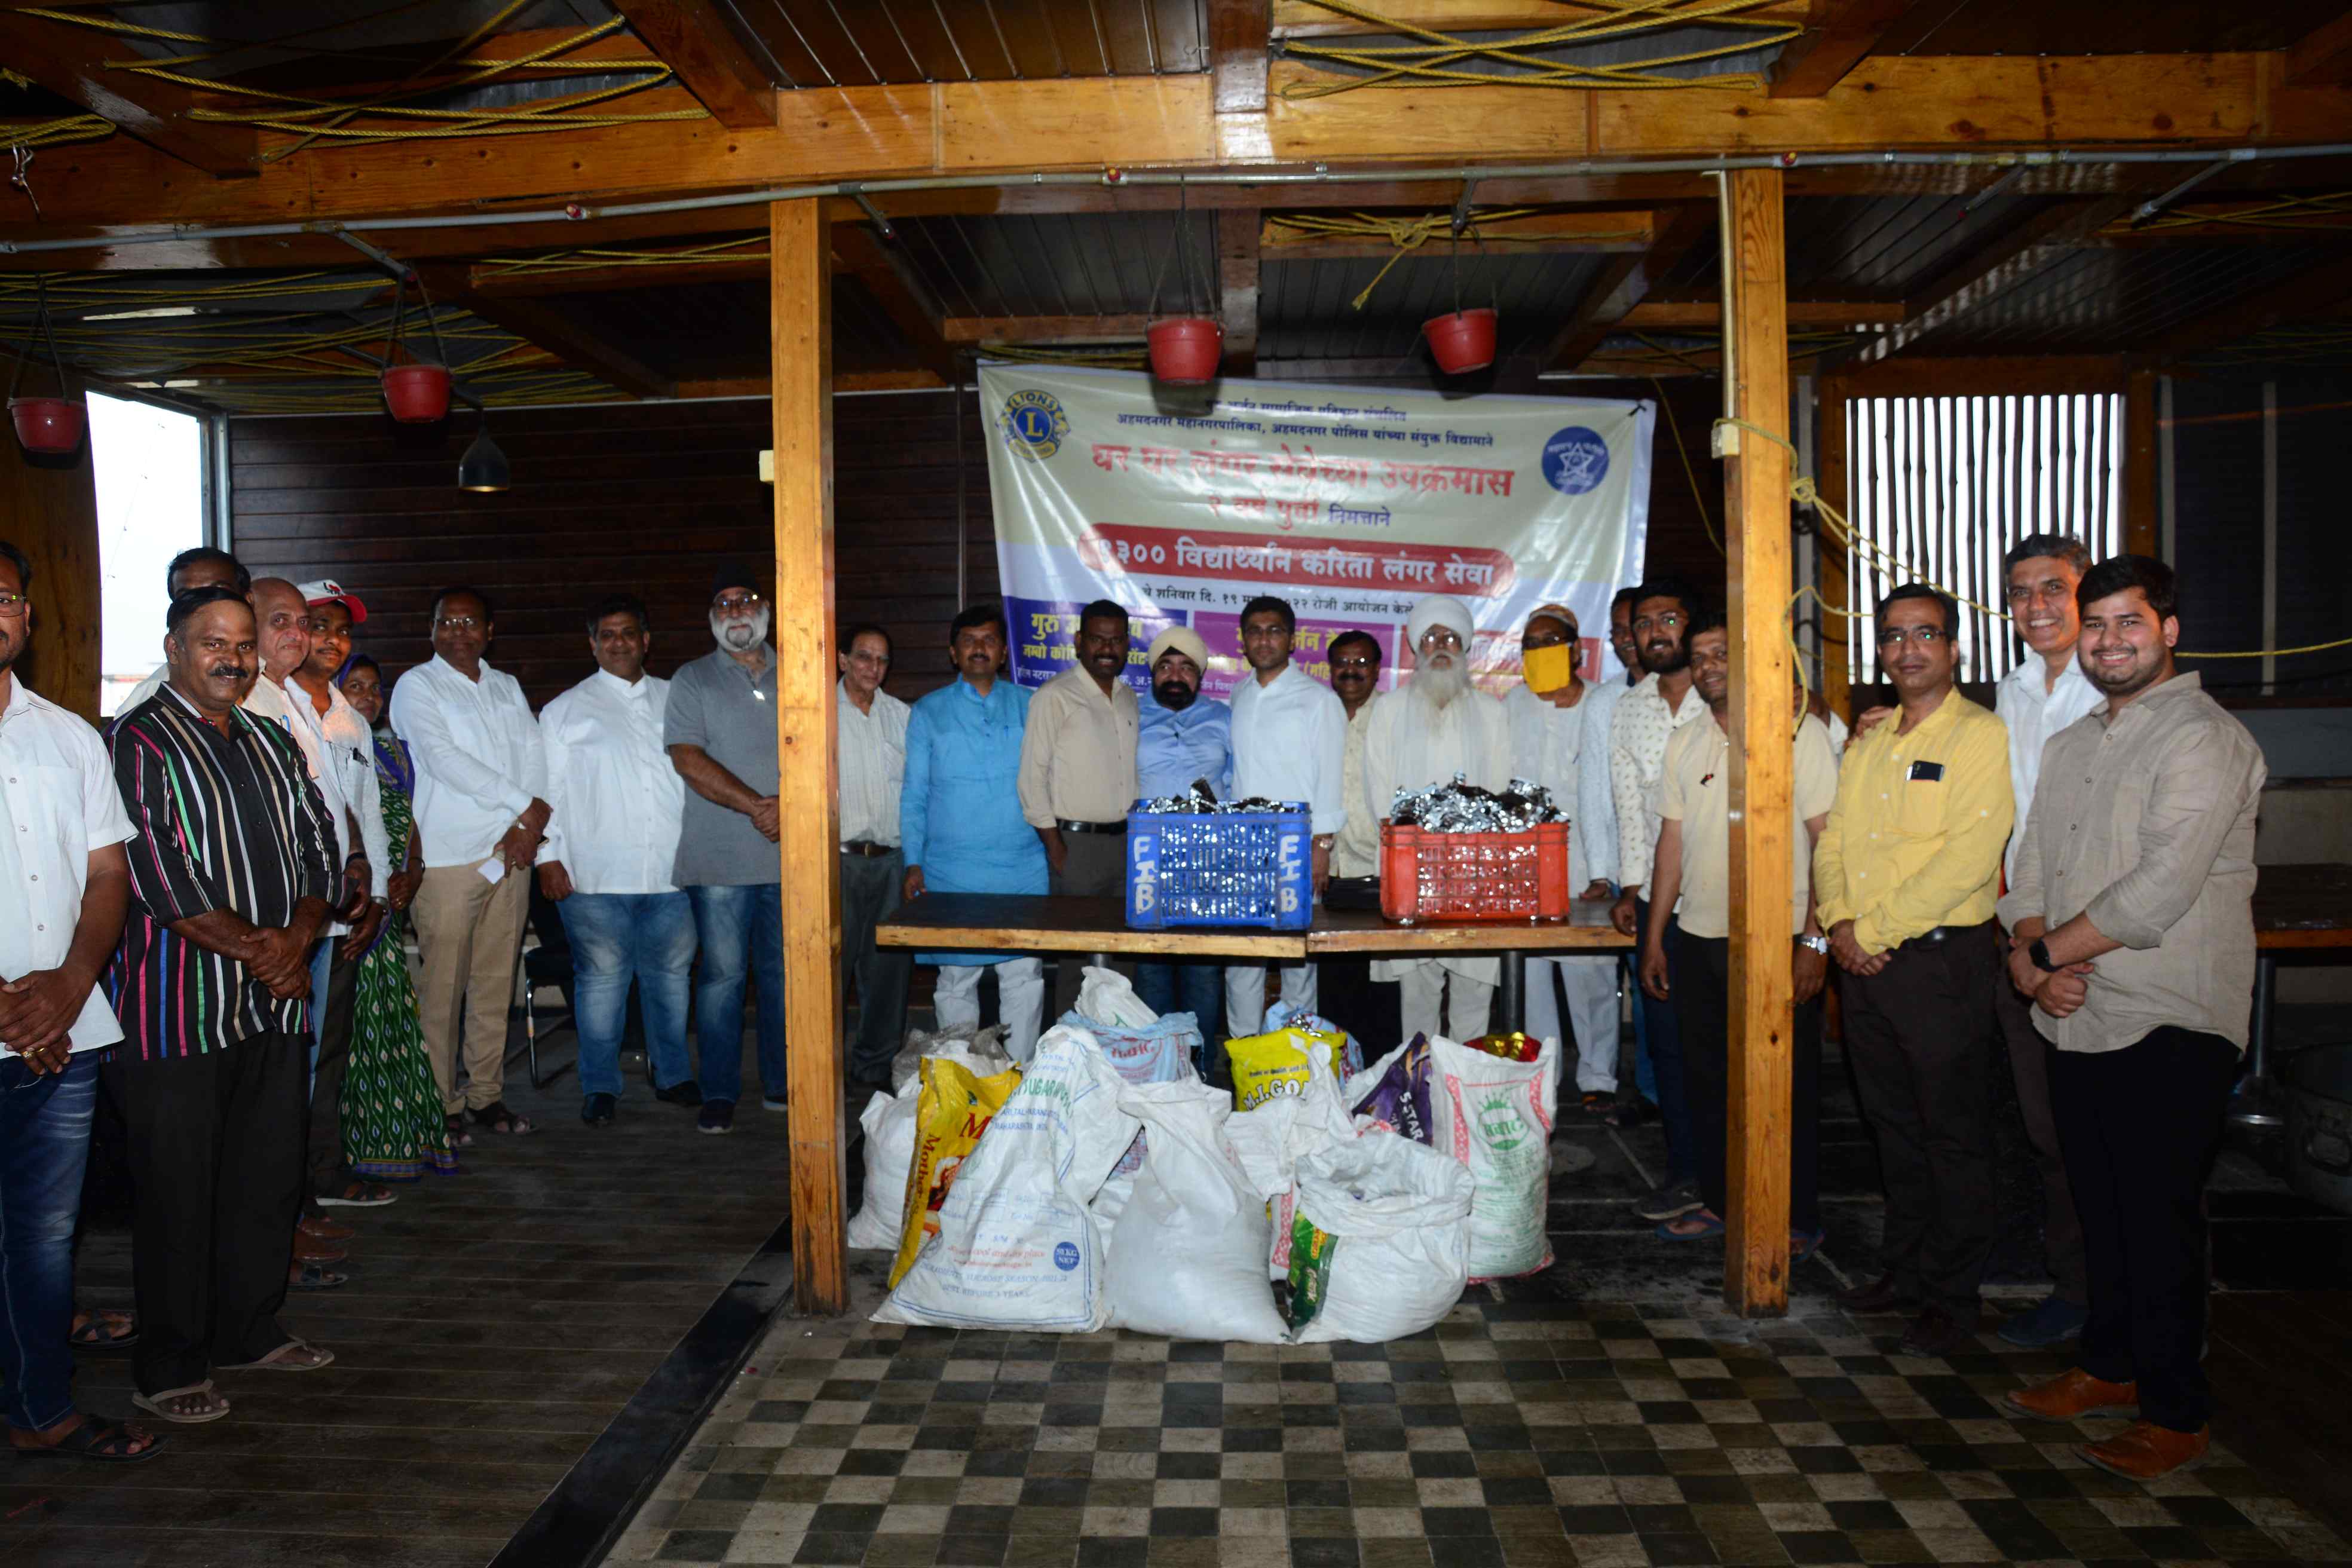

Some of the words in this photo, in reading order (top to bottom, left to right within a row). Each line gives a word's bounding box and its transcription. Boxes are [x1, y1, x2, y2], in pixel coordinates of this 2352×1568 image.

[1009, 392, 1058, 411] LIONS
[1025, 412, 1043, 436] L
[1117, 413, 1172, 427] अहमदनगर
[1271, 422, 1328, 437] अहमदनगर
[1331, 423, 1368, 439] पोलिस
[1092, 443, 1131, 472] घर
[1380, 460, 1515, 497] उपक्रमास
[1300, 546, 1374, 578] करिता
[1382, 550, 1437, 584] लंगर
[1444, 552, 1493, 585] सेवा
[1156, 585, 1196, 600] शनिवार
[1200, 588, 1217, 603] दि.
[1312, 596, 1337, 611] रोजी
[1343, 599, 1388, 614] आयोजन
[1031, 613, 1061, 641] गुरु
